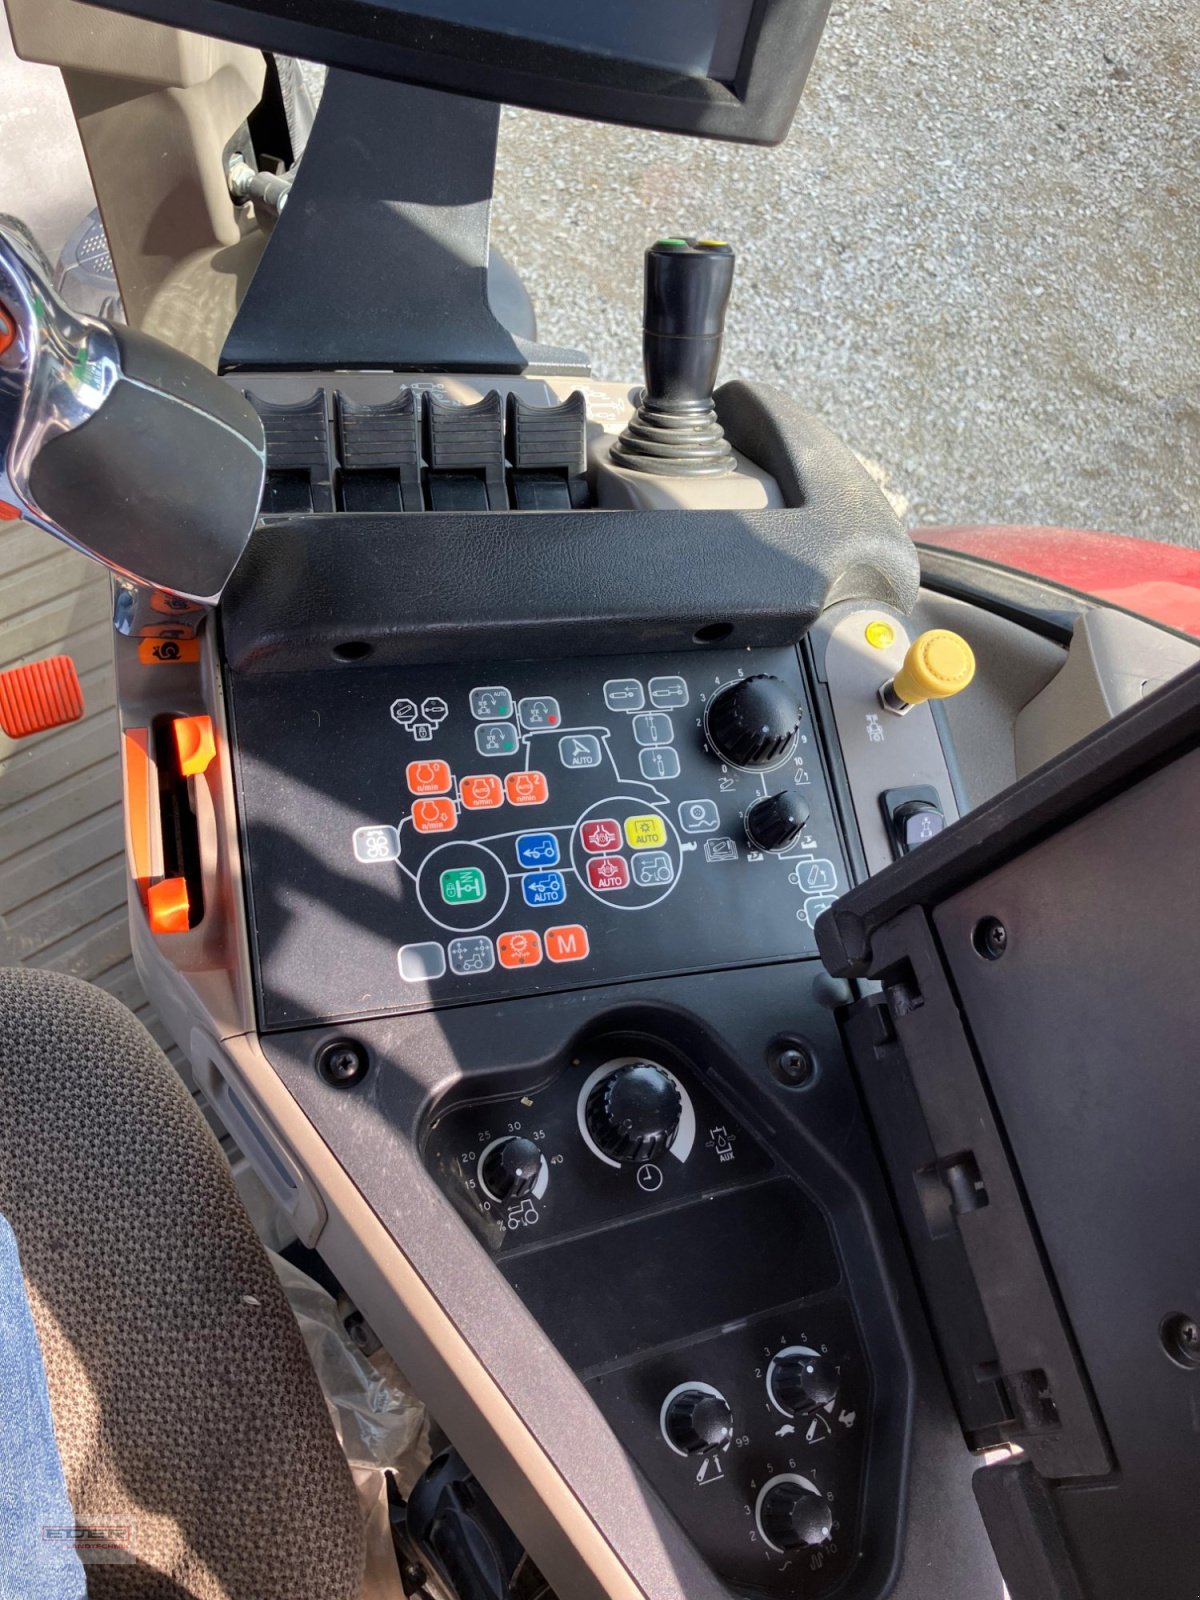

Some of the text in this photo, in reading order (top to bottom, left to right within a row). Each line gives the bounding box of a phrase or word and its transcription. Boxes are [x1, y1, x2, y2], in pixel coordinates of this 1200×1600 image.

[738, 668, 744, 678] 5
[714, 676, 721, 685] 4
[700, 693, 707, 702] 3
[696, 718, 702, 727] 2
[801, 735, 807, 744] 9
[703, 743, 709, 753] 1
[572, 756, 593, 765] AUTO
[794, 756, 803, 766] 10
[721, 764, 728, 774] 0
[489, 778, 496, 789] 1
[533, 774, 541, 785] 2
[416, 784, 439, 792] n/min
[421, 823, 444, 831] n/min
[636, 835, 659, 844] AUTO
[598, 877, 622, 887] AUTO
[534, 892, 559, 902] AUTO
[557, 934, 577, 954] M
[507, 1121, 521, 1132] 30
[478, 1130, 491, 1142] 25
[533, 1129, 546, 1140] 35
[461, 1151, 476, 1162] 20
[550, 1154, 564, 1165] 40
[719, 1152, 735, 1163] AUX
[464, 1178, 476, 1190] 15
[478, 1201, 491, 1212] 10
[496, 1219, 507, 1232] %
[780, 1335, 786, 1345] 4
[801, 1333, 807, 1342] 5
[764, 1347, 771, 1357] 3
[821, 1344, 828, 1354] 6
[754, 1368, 762, 1378] 2
[835, 1366, 841, 1375] 7
[766, 1403, 771, 1412] 1
[735, 1435, 750, 1447] 99
[767, 1463, 774, 1473] 5
[789, 1458, 796, 1469] 6
[811, 1469, 817, 1479] 7
[750, 1479, 757, 1490] 4
[826, 1491, 834, 1501] 8
[744, 1505, 751, 1516] 3
[750, 1531, 757, 1542] 2
[765, 1551, 770, 1560] 1
